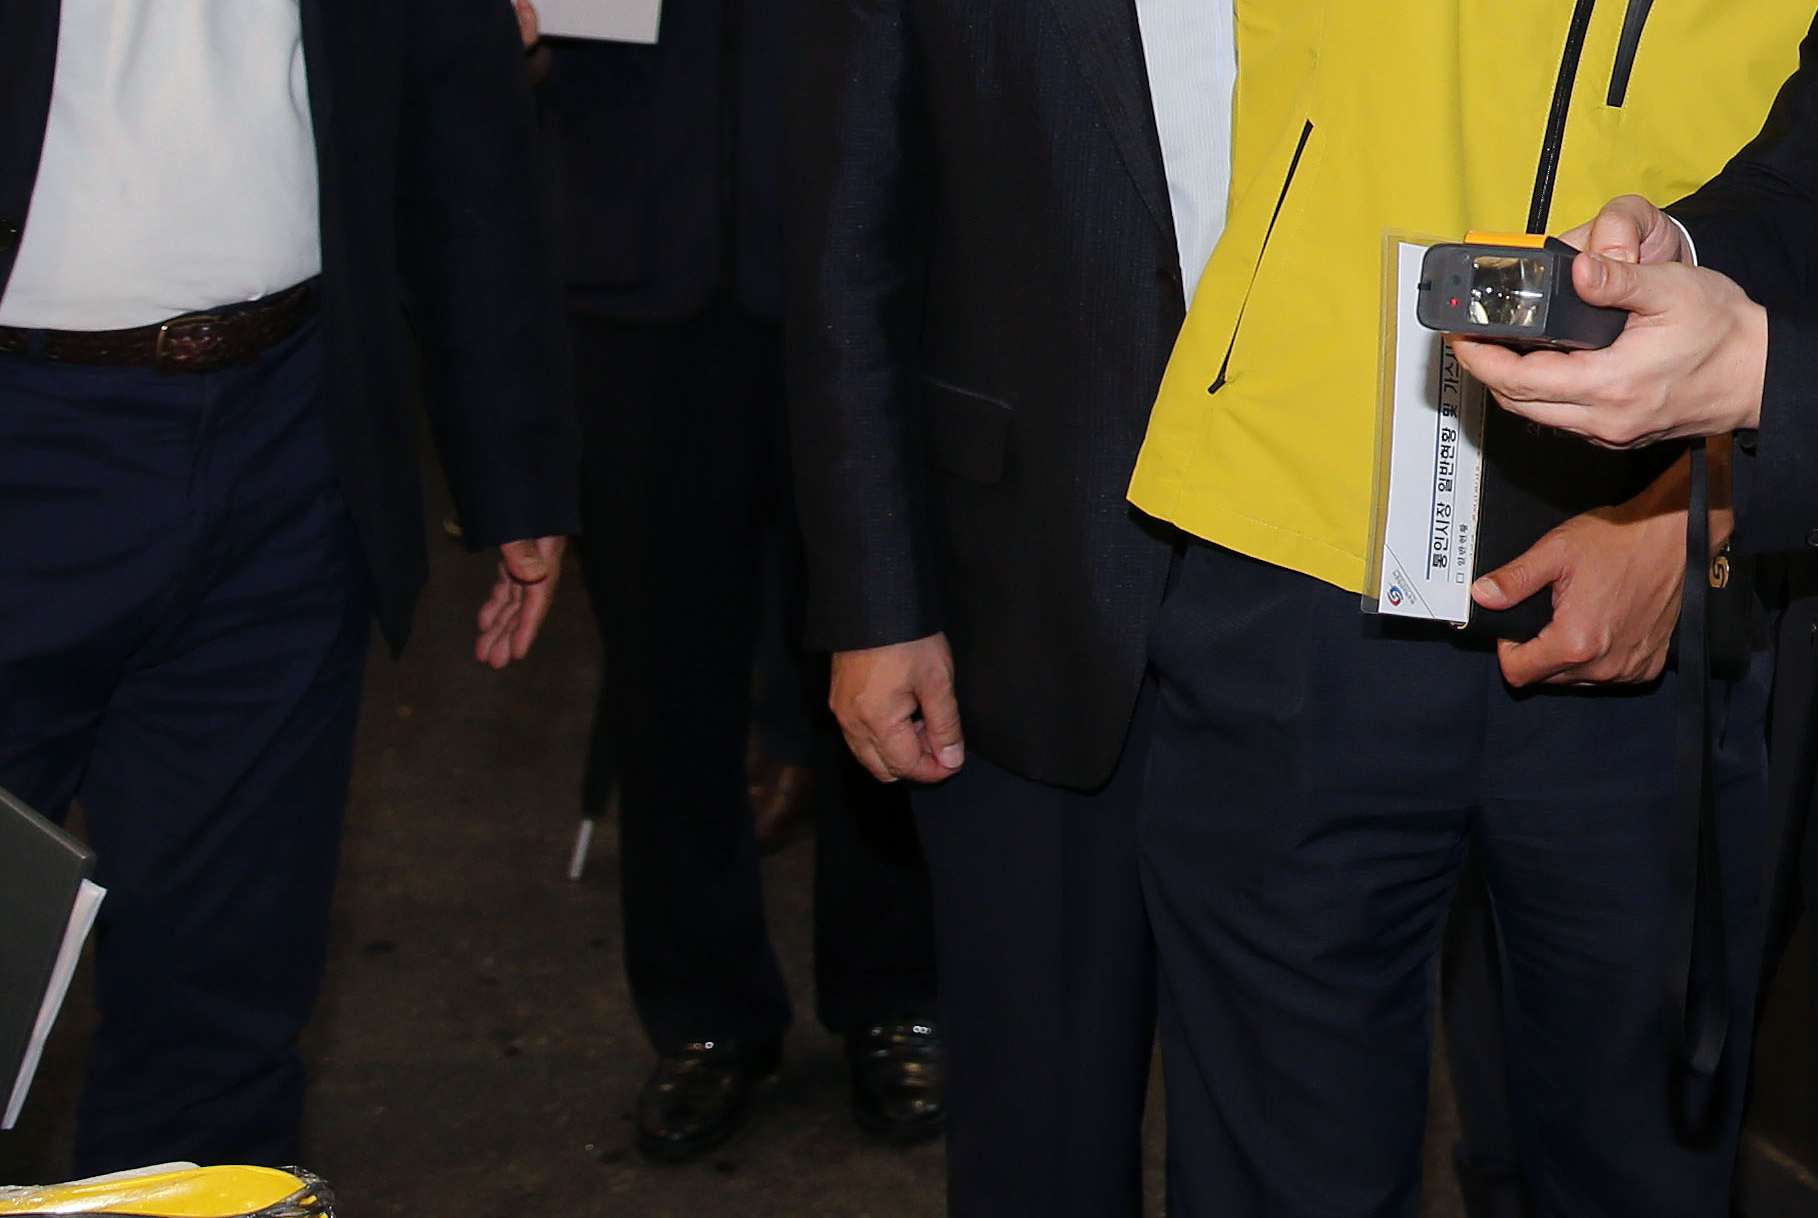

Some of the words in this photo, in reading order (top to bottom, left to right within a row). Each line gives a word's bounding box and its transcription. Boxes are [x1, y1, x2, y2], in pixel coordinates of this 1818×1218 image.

[1442, 403, 1458, 419] 및
[1437, 427, 1457, 493] 일반현황
[1432, 503, 1452, 568] 통인시장
